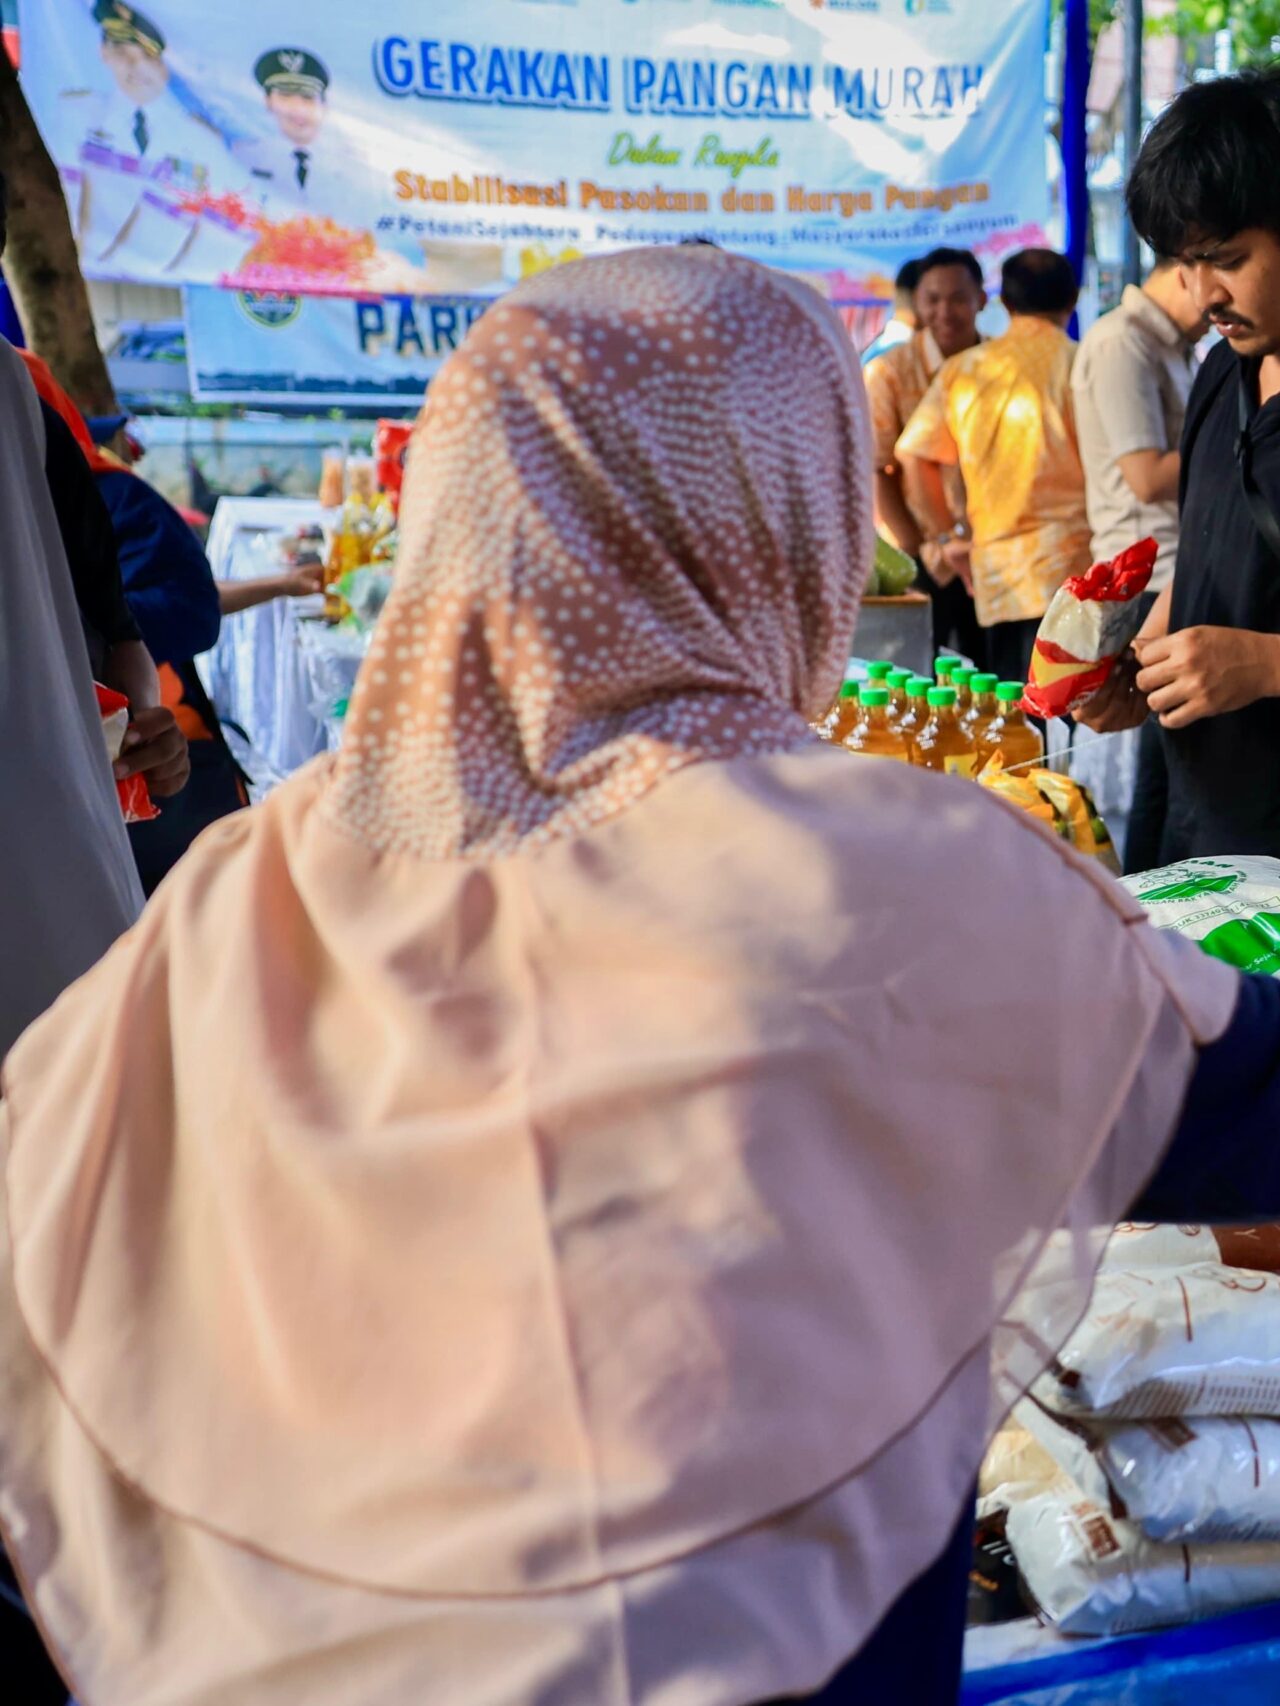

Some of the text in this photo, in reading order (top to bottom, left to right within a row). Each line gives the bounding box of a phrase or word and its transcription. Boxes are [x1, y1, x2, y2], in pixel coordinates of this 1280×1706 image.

[376, 37, 984, 113] GERAKAN PANGAN MURAH
[609, 131, 778, 178] Dalam Rangka
[395, 170, 990, 218] Stabilisasi Pasokan dan Harga Pangan
